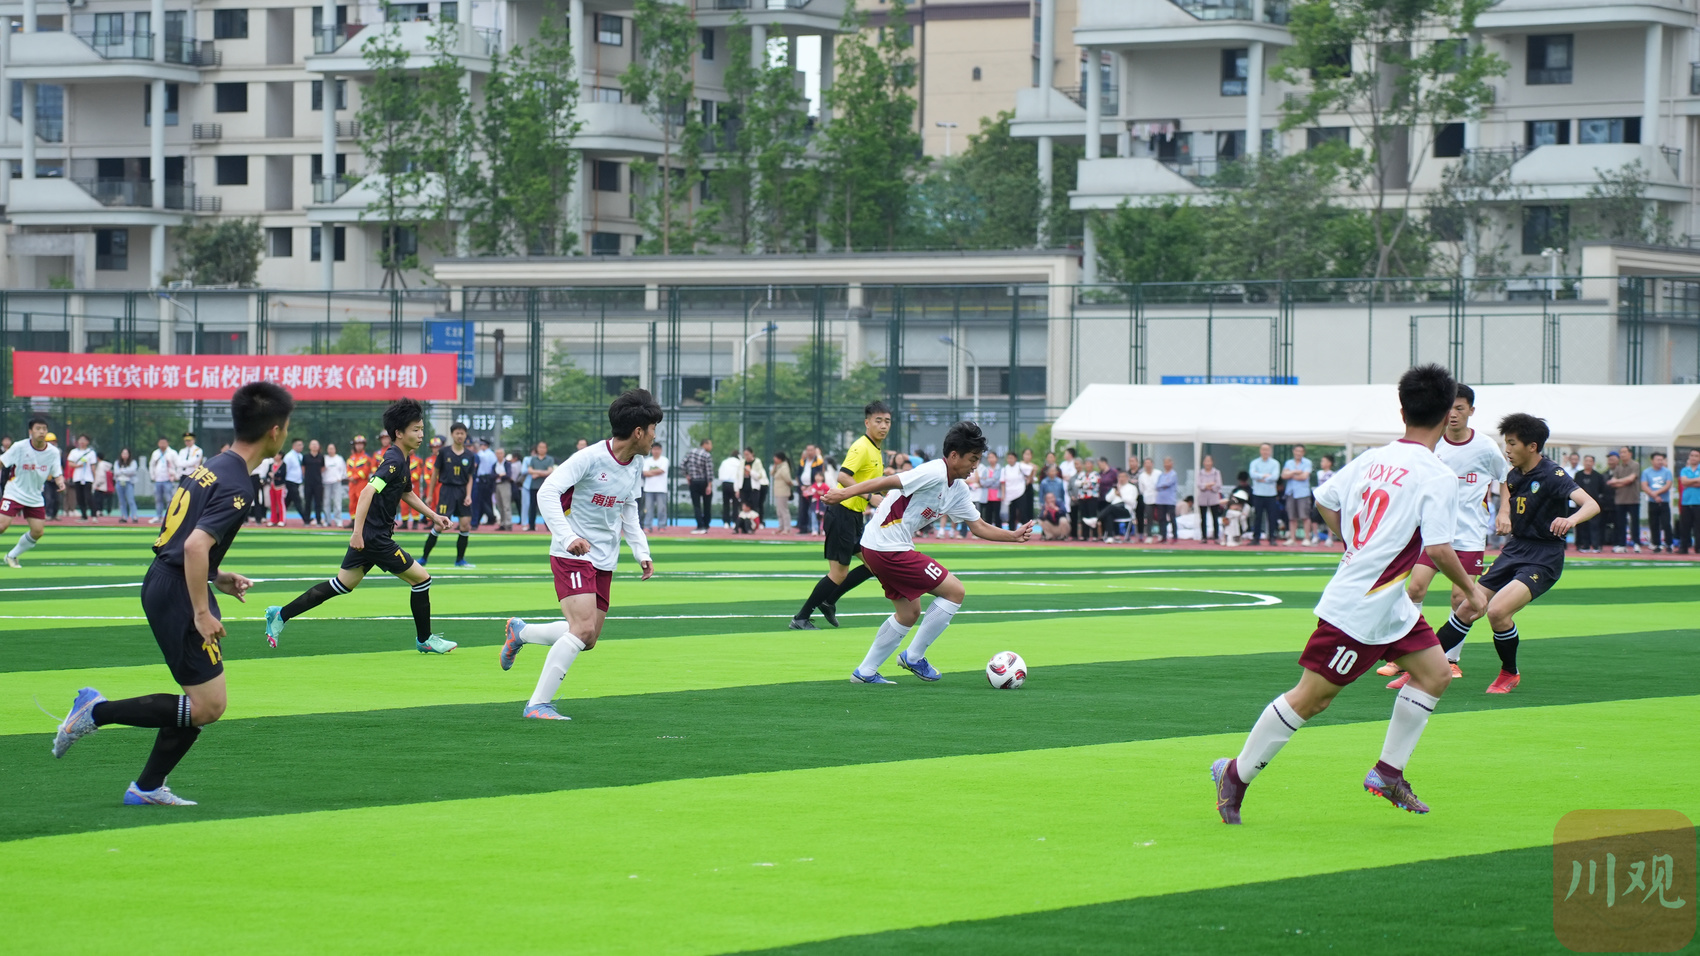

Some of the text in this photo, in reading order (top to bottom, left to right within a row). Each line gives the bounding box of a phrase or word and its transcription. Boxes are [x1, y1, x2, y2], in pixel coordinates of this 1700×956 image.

[453, 465, 461, 476] 11
[1363, 463, 1410, 488] NXYZ
[439, 504, 448, 514] 11
[1516, 496, 1527, 515] 15
[1352, 486, 1390, 551] 10
[394, 549, 407, 565] 7
[570, 571, 583, 589] 11
[924, 562, 943, 581] 16
[1327, 645, 1358, 675] 10
